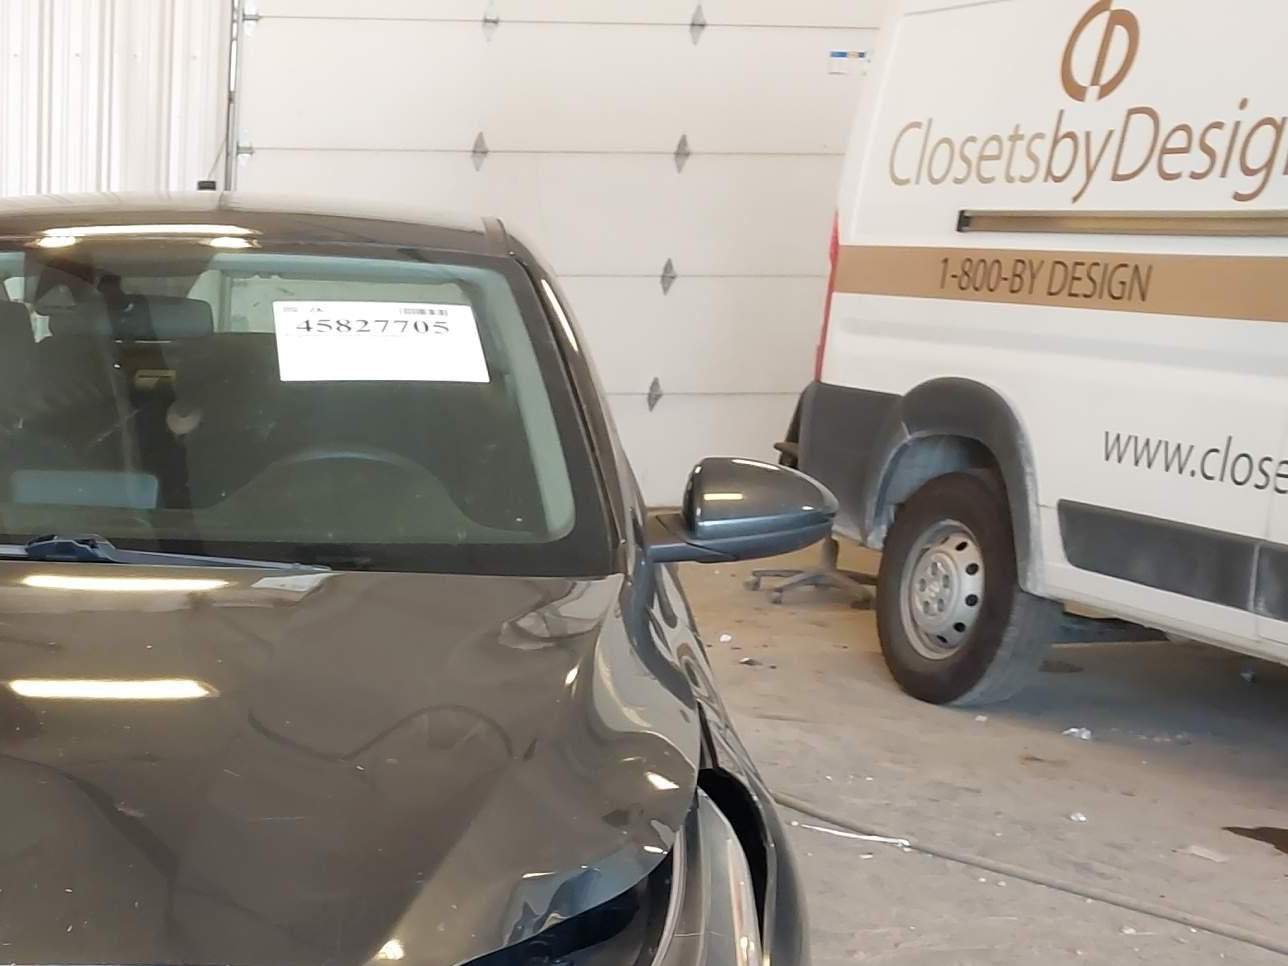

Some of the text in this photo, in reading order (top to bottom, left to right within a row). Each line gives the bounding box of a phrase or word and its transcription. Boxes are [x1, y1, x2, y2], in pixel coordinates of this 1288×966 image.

[888, 97, 1288, 203] ClosetsbyDesig
[939, 257, 1153, 302] 1-800-BY DESIGN
[295, 318, 450, 335] 45827705
